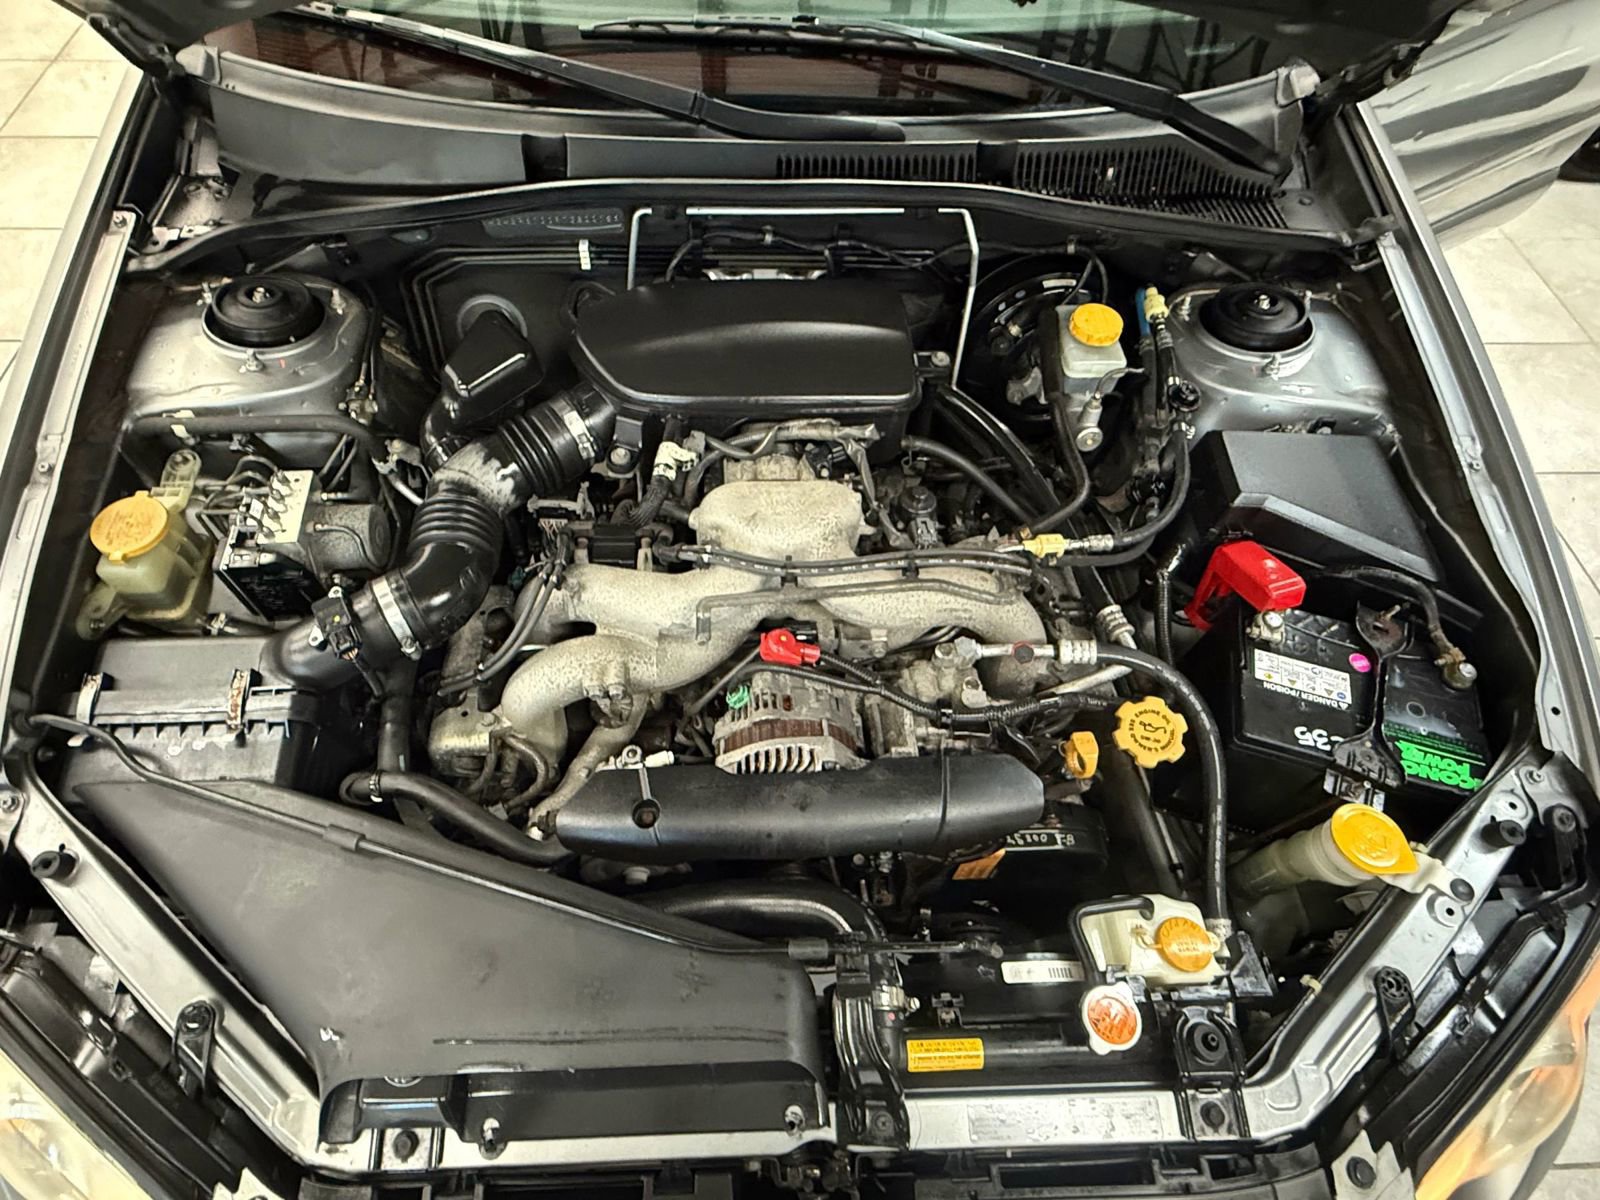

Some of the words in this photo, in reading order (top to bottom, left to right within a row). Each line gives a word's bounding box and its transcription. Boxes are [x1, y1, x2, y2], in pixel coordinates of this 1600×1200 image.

[1263, 681, 1297, 697] POISON
[1301, 691, 1338, 708] DANGER
[1396, 741, 1471, 777] POWER
